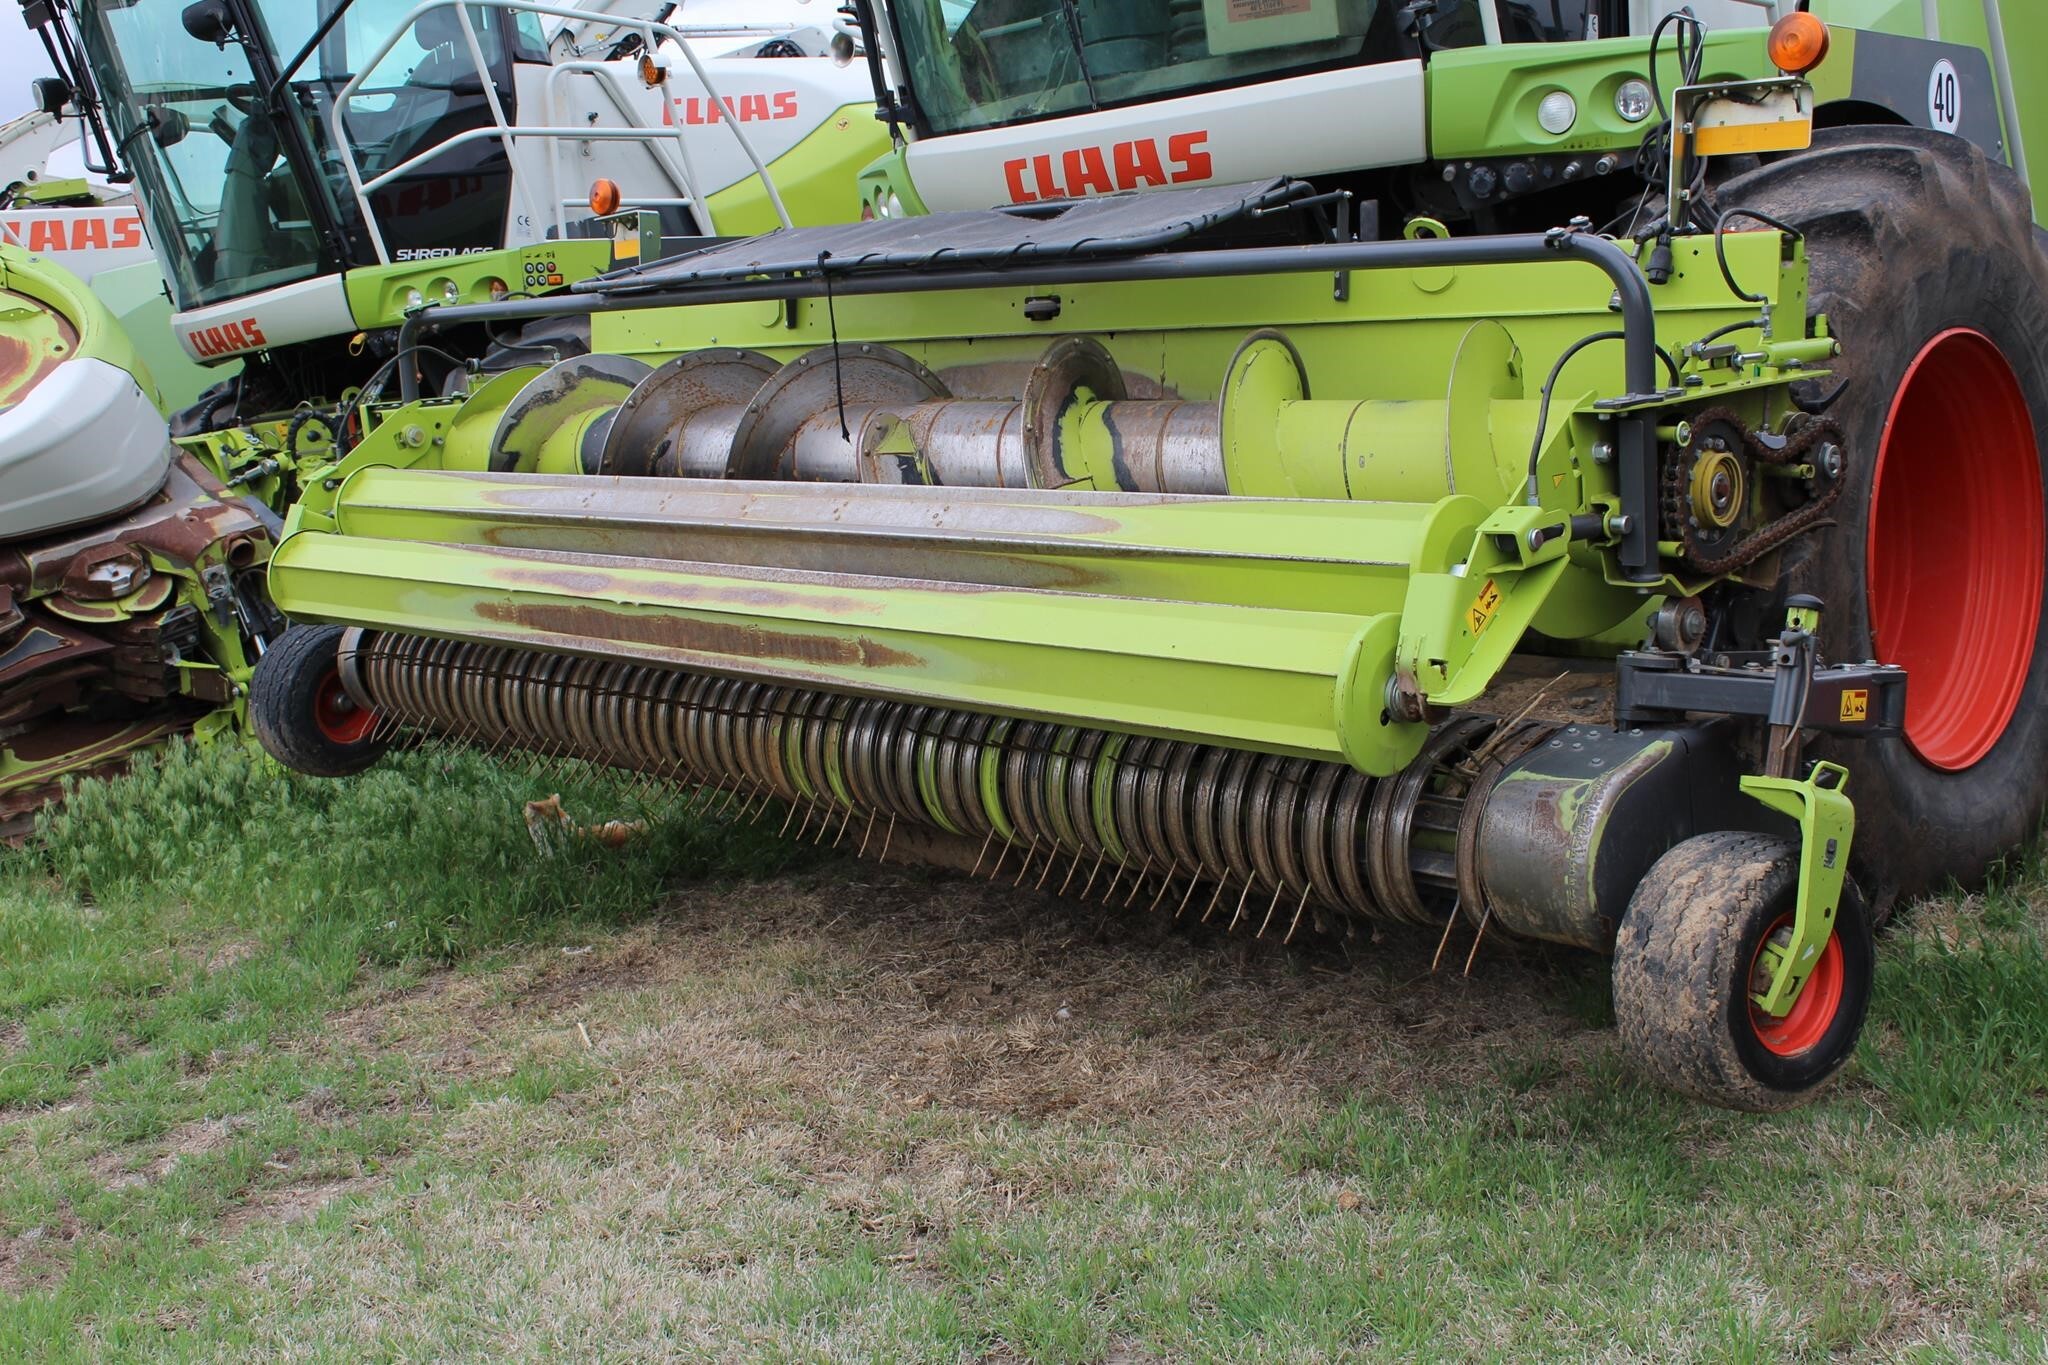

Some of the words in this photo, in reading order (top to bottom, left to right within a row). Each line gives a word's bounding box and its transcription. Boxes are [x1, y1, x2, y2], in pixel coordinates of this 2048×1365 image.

[662, 91, 798, 126] CLAAS
[1934, 72, 1955, 123] 40
[1003, 130, 1213, 204] CLAAS
[188, 317, 267, 357] CLAAS
